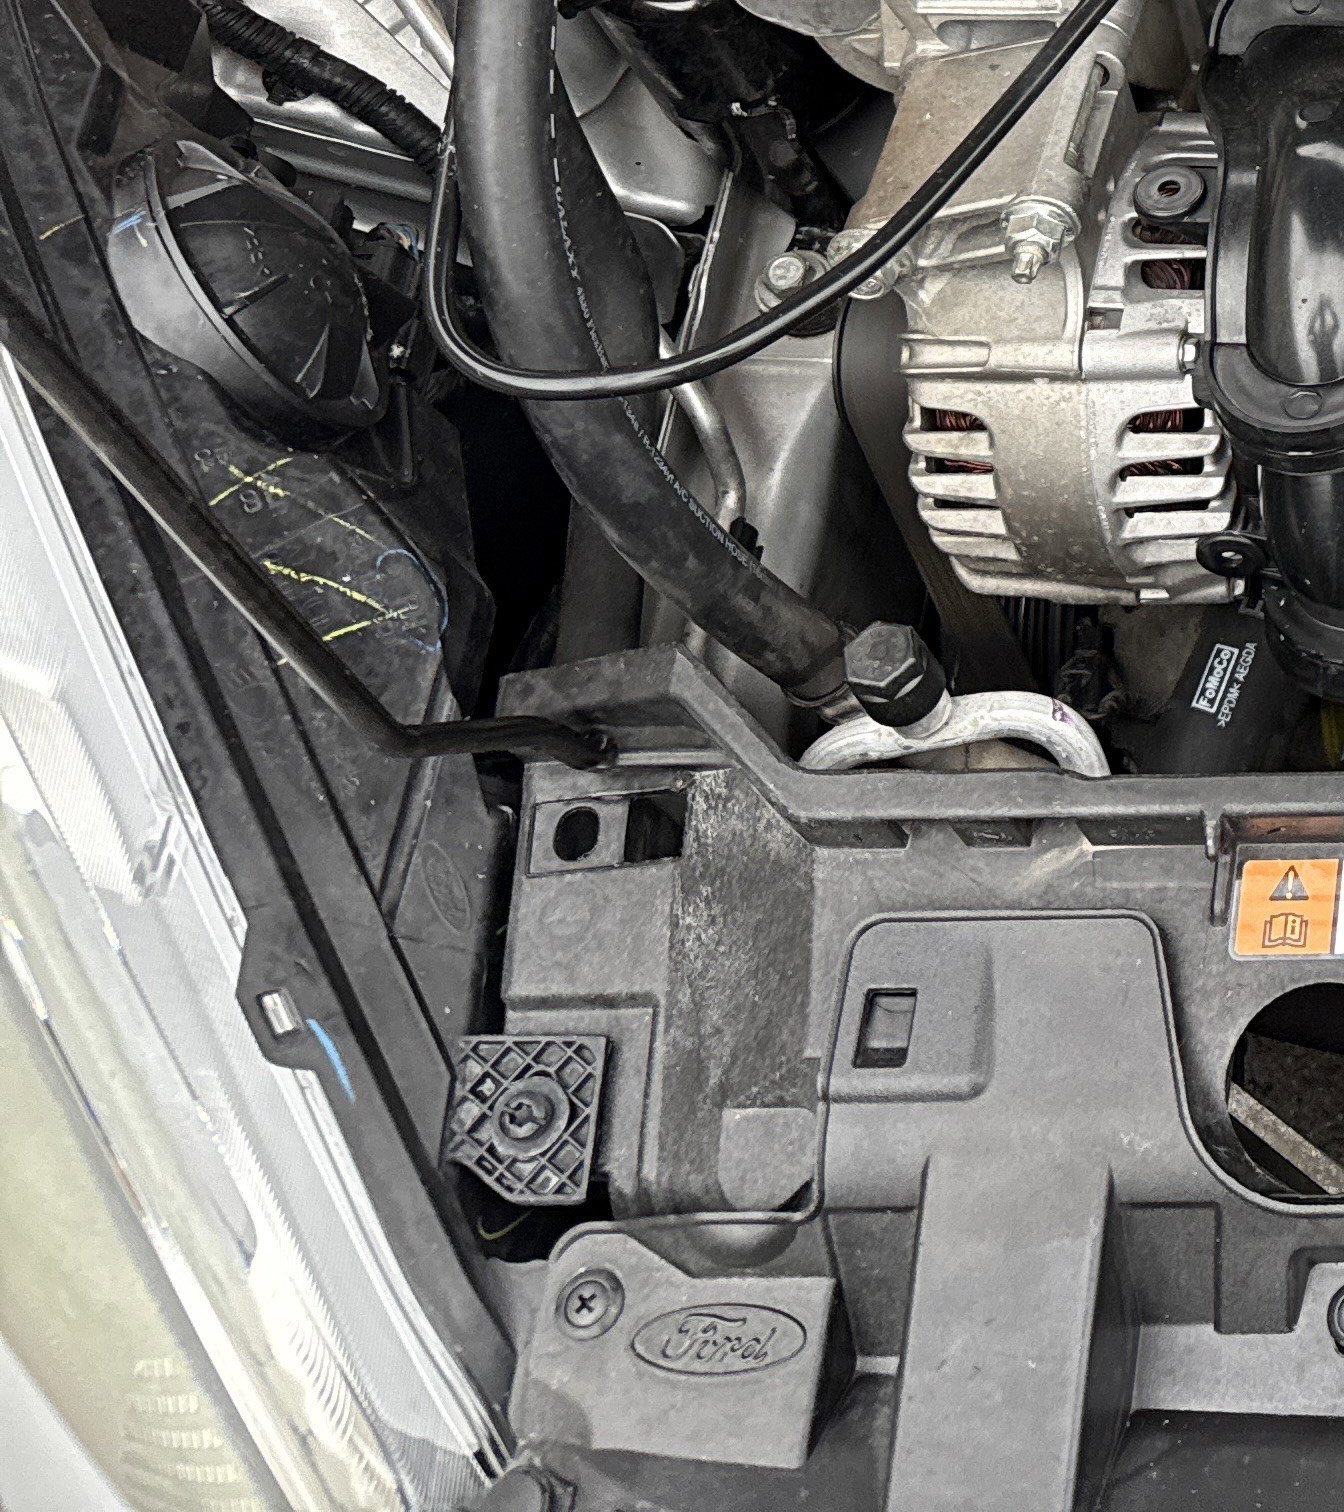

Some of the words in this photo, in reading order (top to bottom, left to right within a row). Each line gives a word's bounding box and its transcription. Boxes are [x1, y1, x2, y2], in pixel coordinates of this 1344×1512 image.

[687, 497, 728, 545] SUCTION
[1198, 645, 1234, 711] FoMoCo
[660, 1310, 774, 1366] Ford
